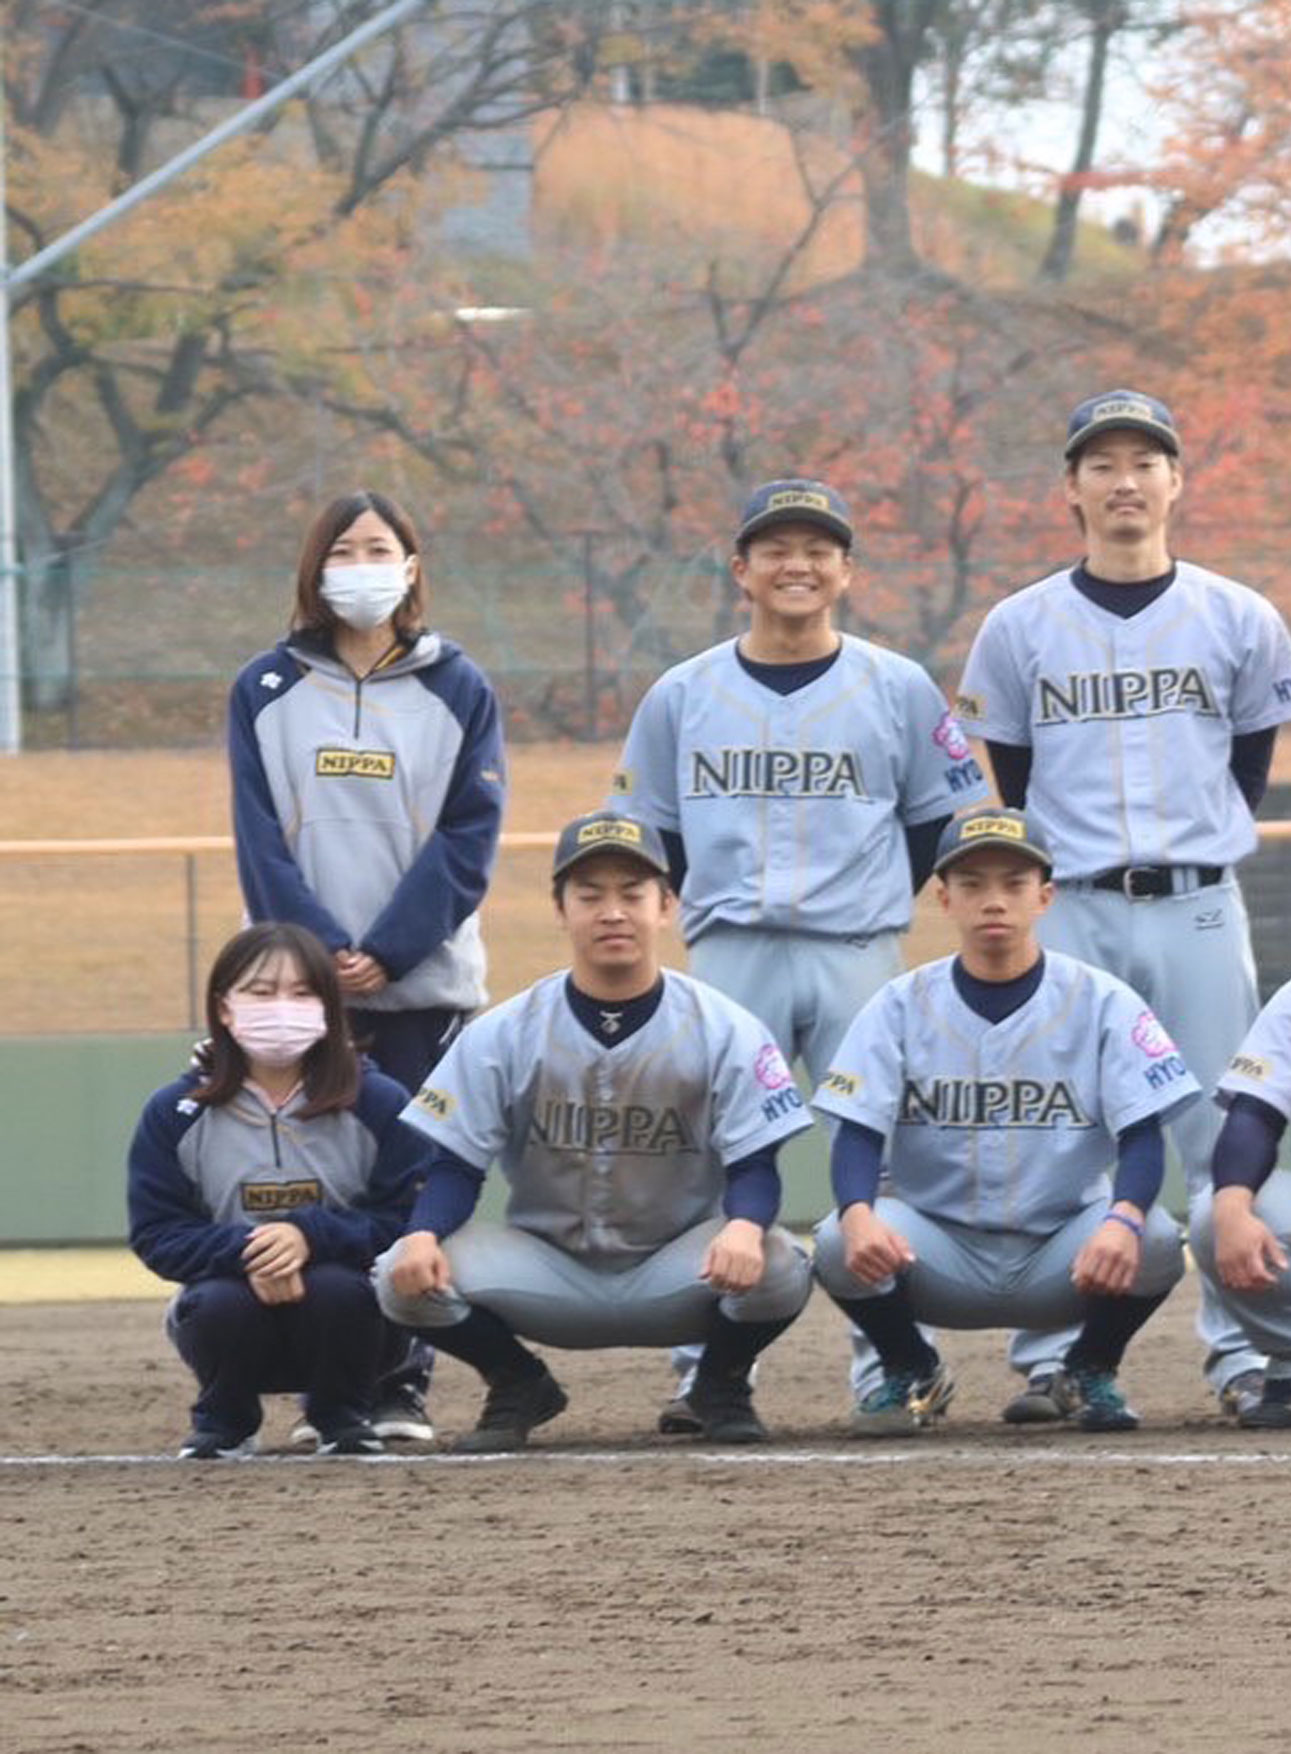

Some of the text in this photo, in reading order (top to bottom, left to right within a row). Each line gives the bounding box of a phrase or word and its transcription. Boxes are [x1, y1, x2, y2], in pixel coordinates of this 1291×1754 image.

[1097, 402, 1147, 415] NIPPA
[772, 495, 823, 507] NIPPA
[1036, 667, 1220, 726] NIPPA
[324, 756, 388, 774] NIPPA
[690, 750, 866, 800] NIPPA
[582, 823, 638, 837] NIPPA
[965, 819, 1020, 834] NIPPA
[900, 1080, 1098, 1132] NIPPA
[528, 1103, 697, 1153] NIPPA
[247, 1187, 316, 1206] NIPPA
